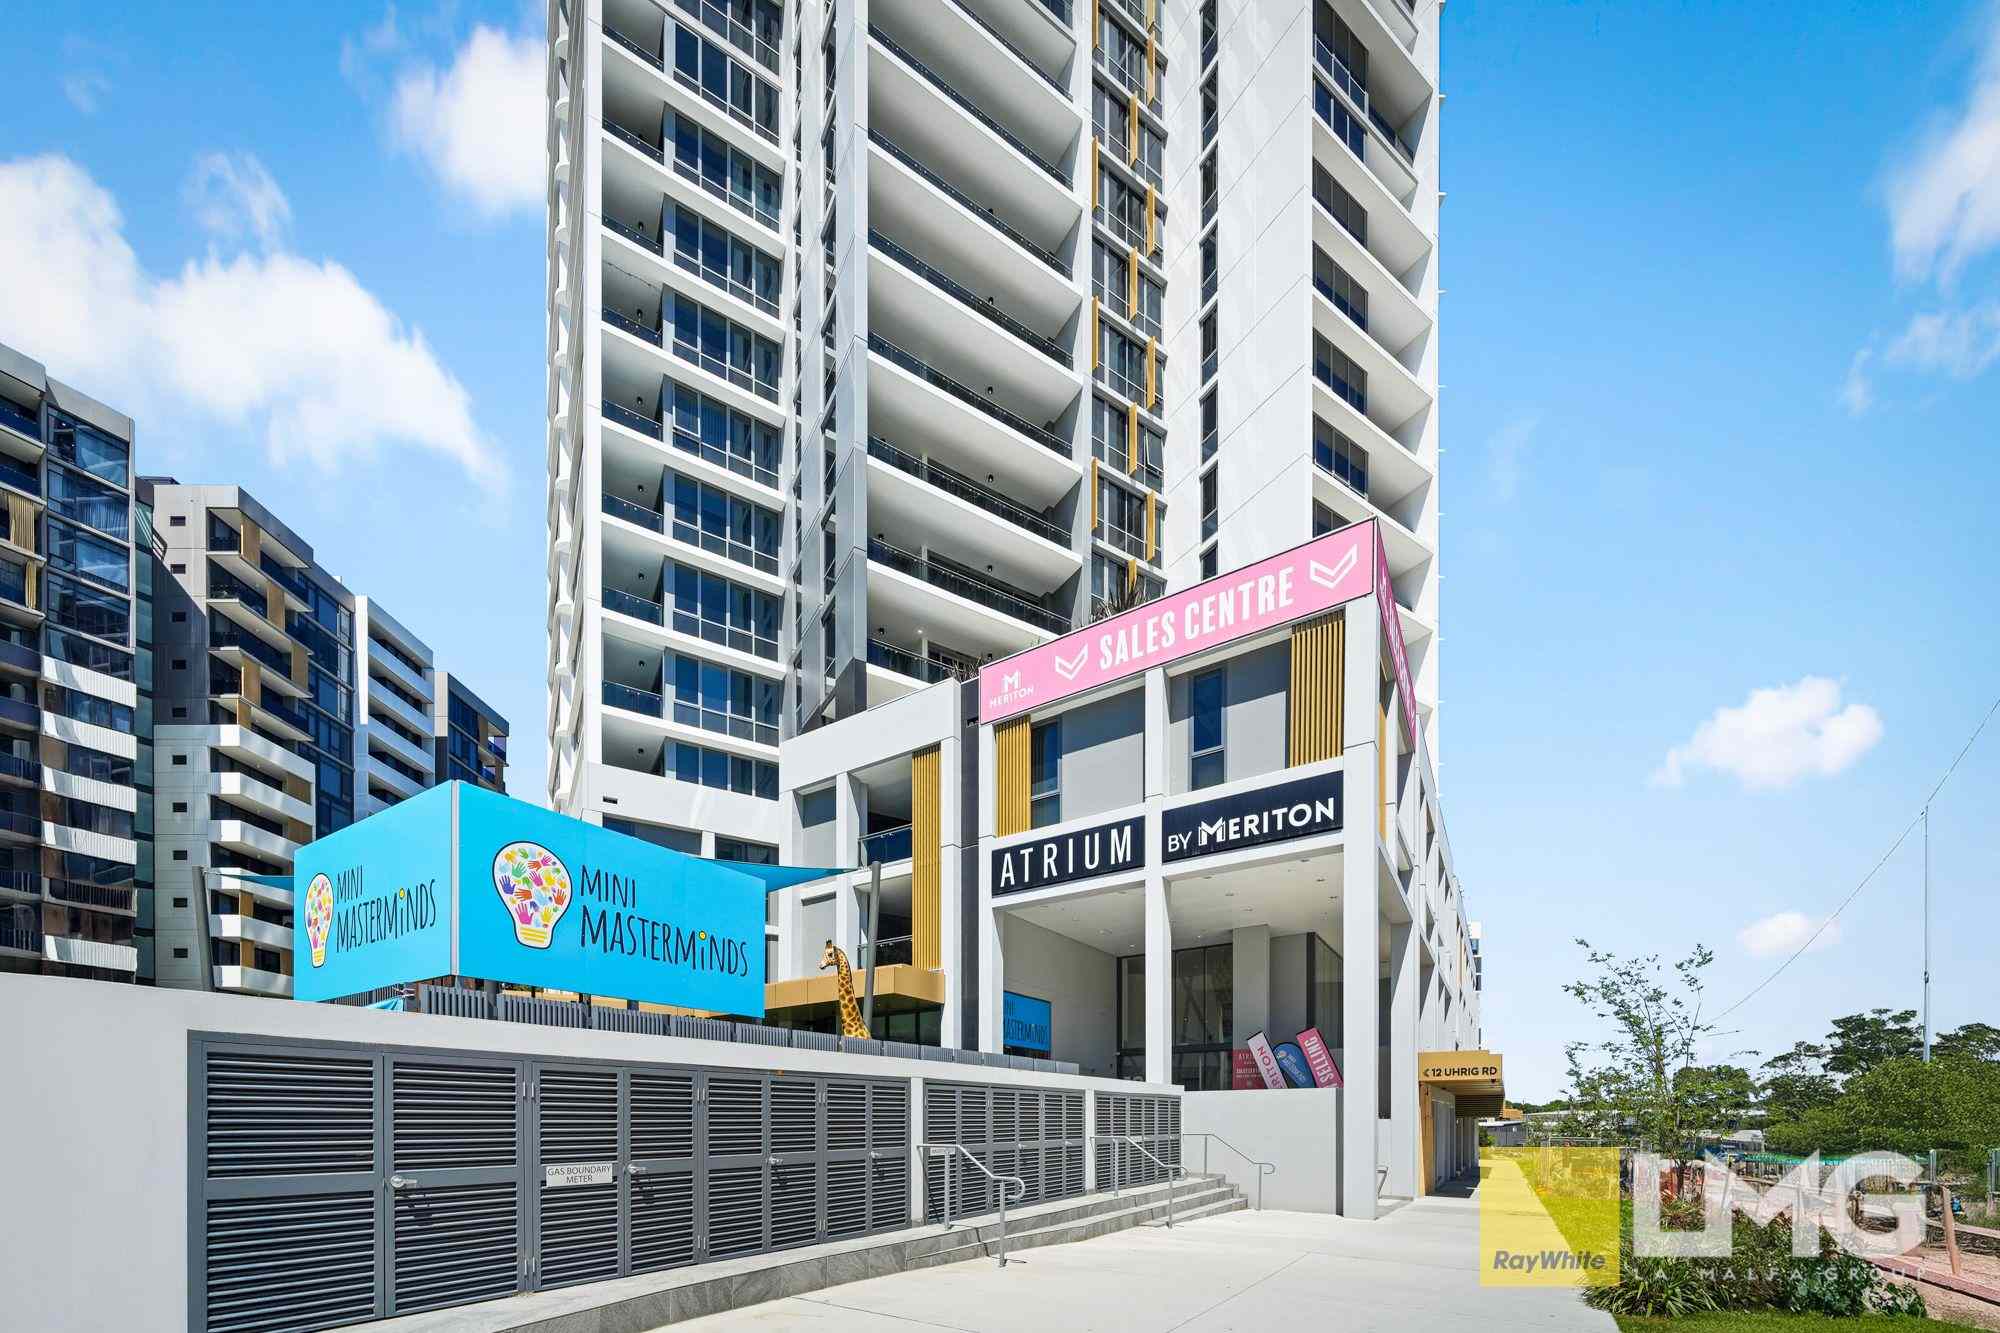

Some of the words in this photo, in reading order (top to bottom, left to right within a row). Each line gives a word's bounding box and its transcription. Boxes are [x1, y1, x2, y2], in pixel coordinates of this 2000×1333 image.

[1099, 617, 1176, 671] SALES
[1184, 566, 1295, 640] CENTRE
[989, 685, 1034, 708] MERITON
[1167, 830, 1193, 853] BY
[1198, 798, 1336, 847] MERITON
[1000, 825, 1132, 888] ATRIUM
[336, 864, 364, 905] MINI
[580, 863, 637, 907] MINI
[1304, 1036, 1335, 1083] SELLING
[1431, 1068, 1442, 1077] 12
[1444, 1067, 1479, 1077] UHRIG
[1481, 1066, 1497, 1075] RD
[548, 1167, 565, 1176] GAS
[566, 1165, 611, 1175] BOUNDARY
[566, 1175, 593, 1183] METER
